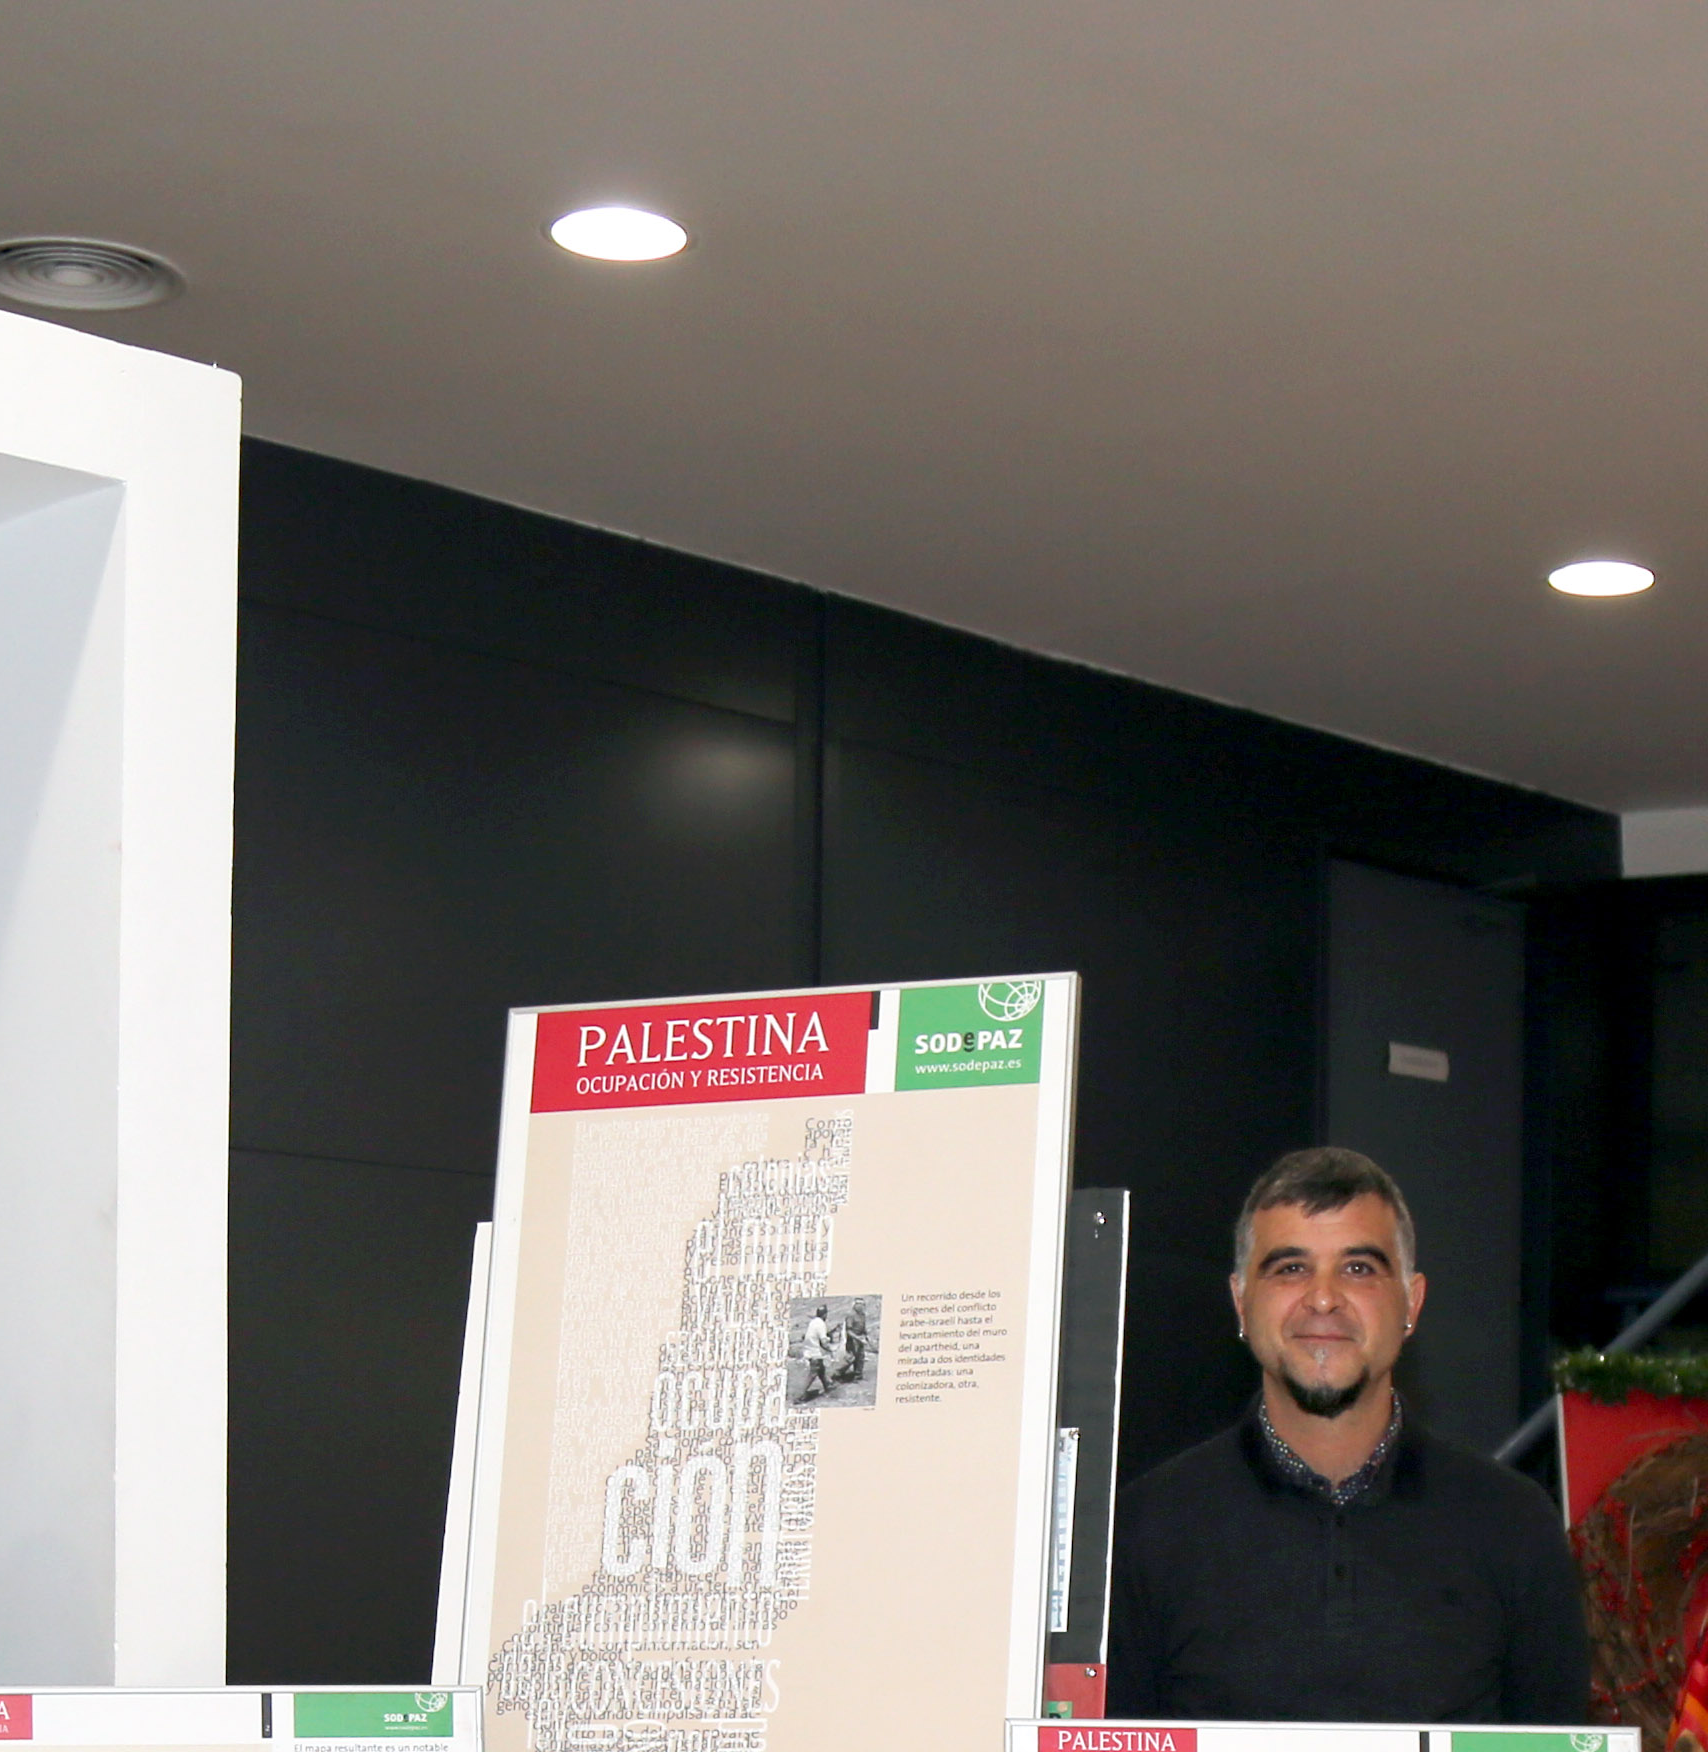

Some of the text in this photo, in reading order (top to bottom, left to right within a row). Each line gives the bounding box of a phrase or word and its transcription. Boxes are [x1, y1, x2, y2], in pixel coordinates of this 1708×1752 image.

[577, 1013, 829, 1066] PALESTINA
[915, 1059, 1022, 1073] www.sodepaz.es
[576, 1064, 823, 1094] OCUPACIÓN Y RESISTENCIA
[901, 1290, 1001, 1302] Un recorrido desde los
[941, 1304, 955, 1313] del
[957, 1303, 997, 1312] conflicto
[957, 1317, 982, 1325] hasta
[984, 1315, 993, 1324] el
[899, 1330, 965, 1340] levantamiento
[966, 1328, 980, 1337] del
[898, 1344, 912, 1353] del
[914, 1342, 960, 1353] apartheid,
[898, 1356, 928, 1365] mirada
[937, 1355, 953, 1364] dos
[954, 1353, 1006, 1363] identidades
[896, 1368, 974, 1378] enfrentadas: una
[895, 1380, 979, 1391] colonizadora, otra,
[895, 1394, 942, 1403] resistente.
[603, 1438, 784, 1586] ción
[1058, 1731, 1176, 1751] PALESTINA
[294, 1744, 302, 1752] El
[335, 1744, 383, 1752] resultante
[412, 1743, 449, 1752] notable
